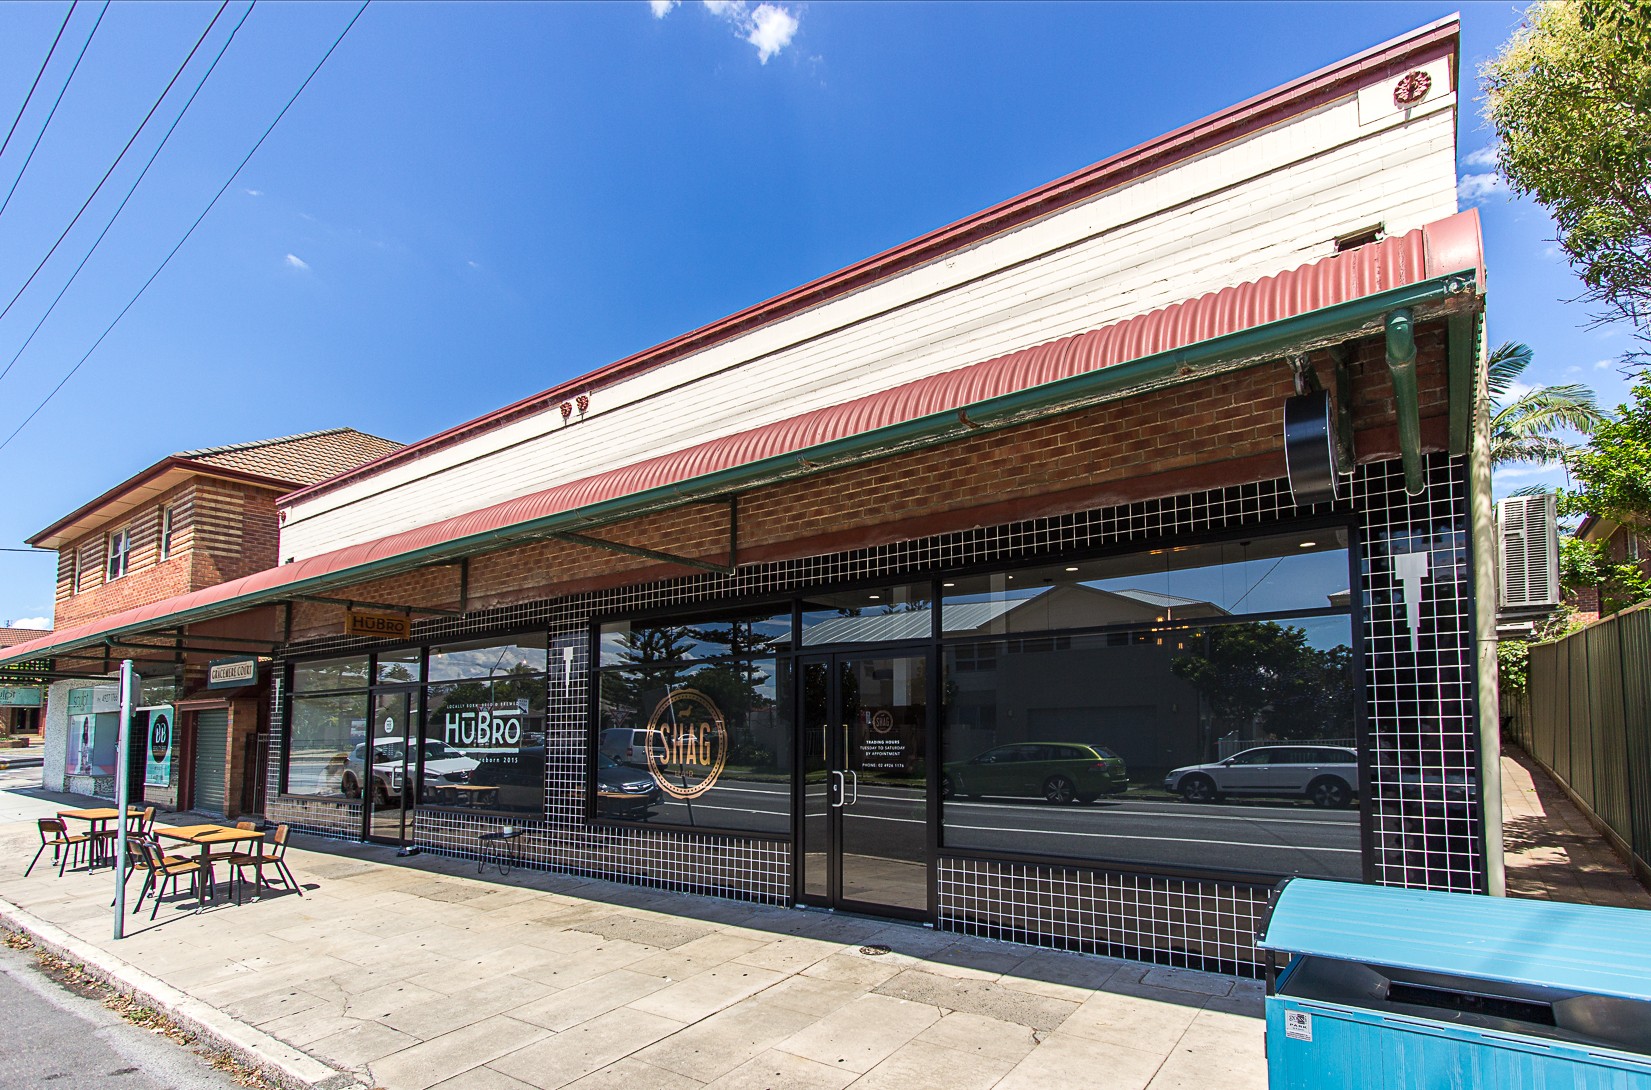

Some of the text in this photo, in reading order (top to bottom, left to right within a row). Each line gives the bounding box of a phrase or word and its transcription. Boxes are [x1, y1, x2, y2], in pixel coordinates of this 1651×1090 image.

[212, 665, 252, 680] GRACEMERE COURT
[876, 717, 890, 727] SHAG
[660, 722, 711, 766] SHAG
[674, 770, 694, 778] HAIR
